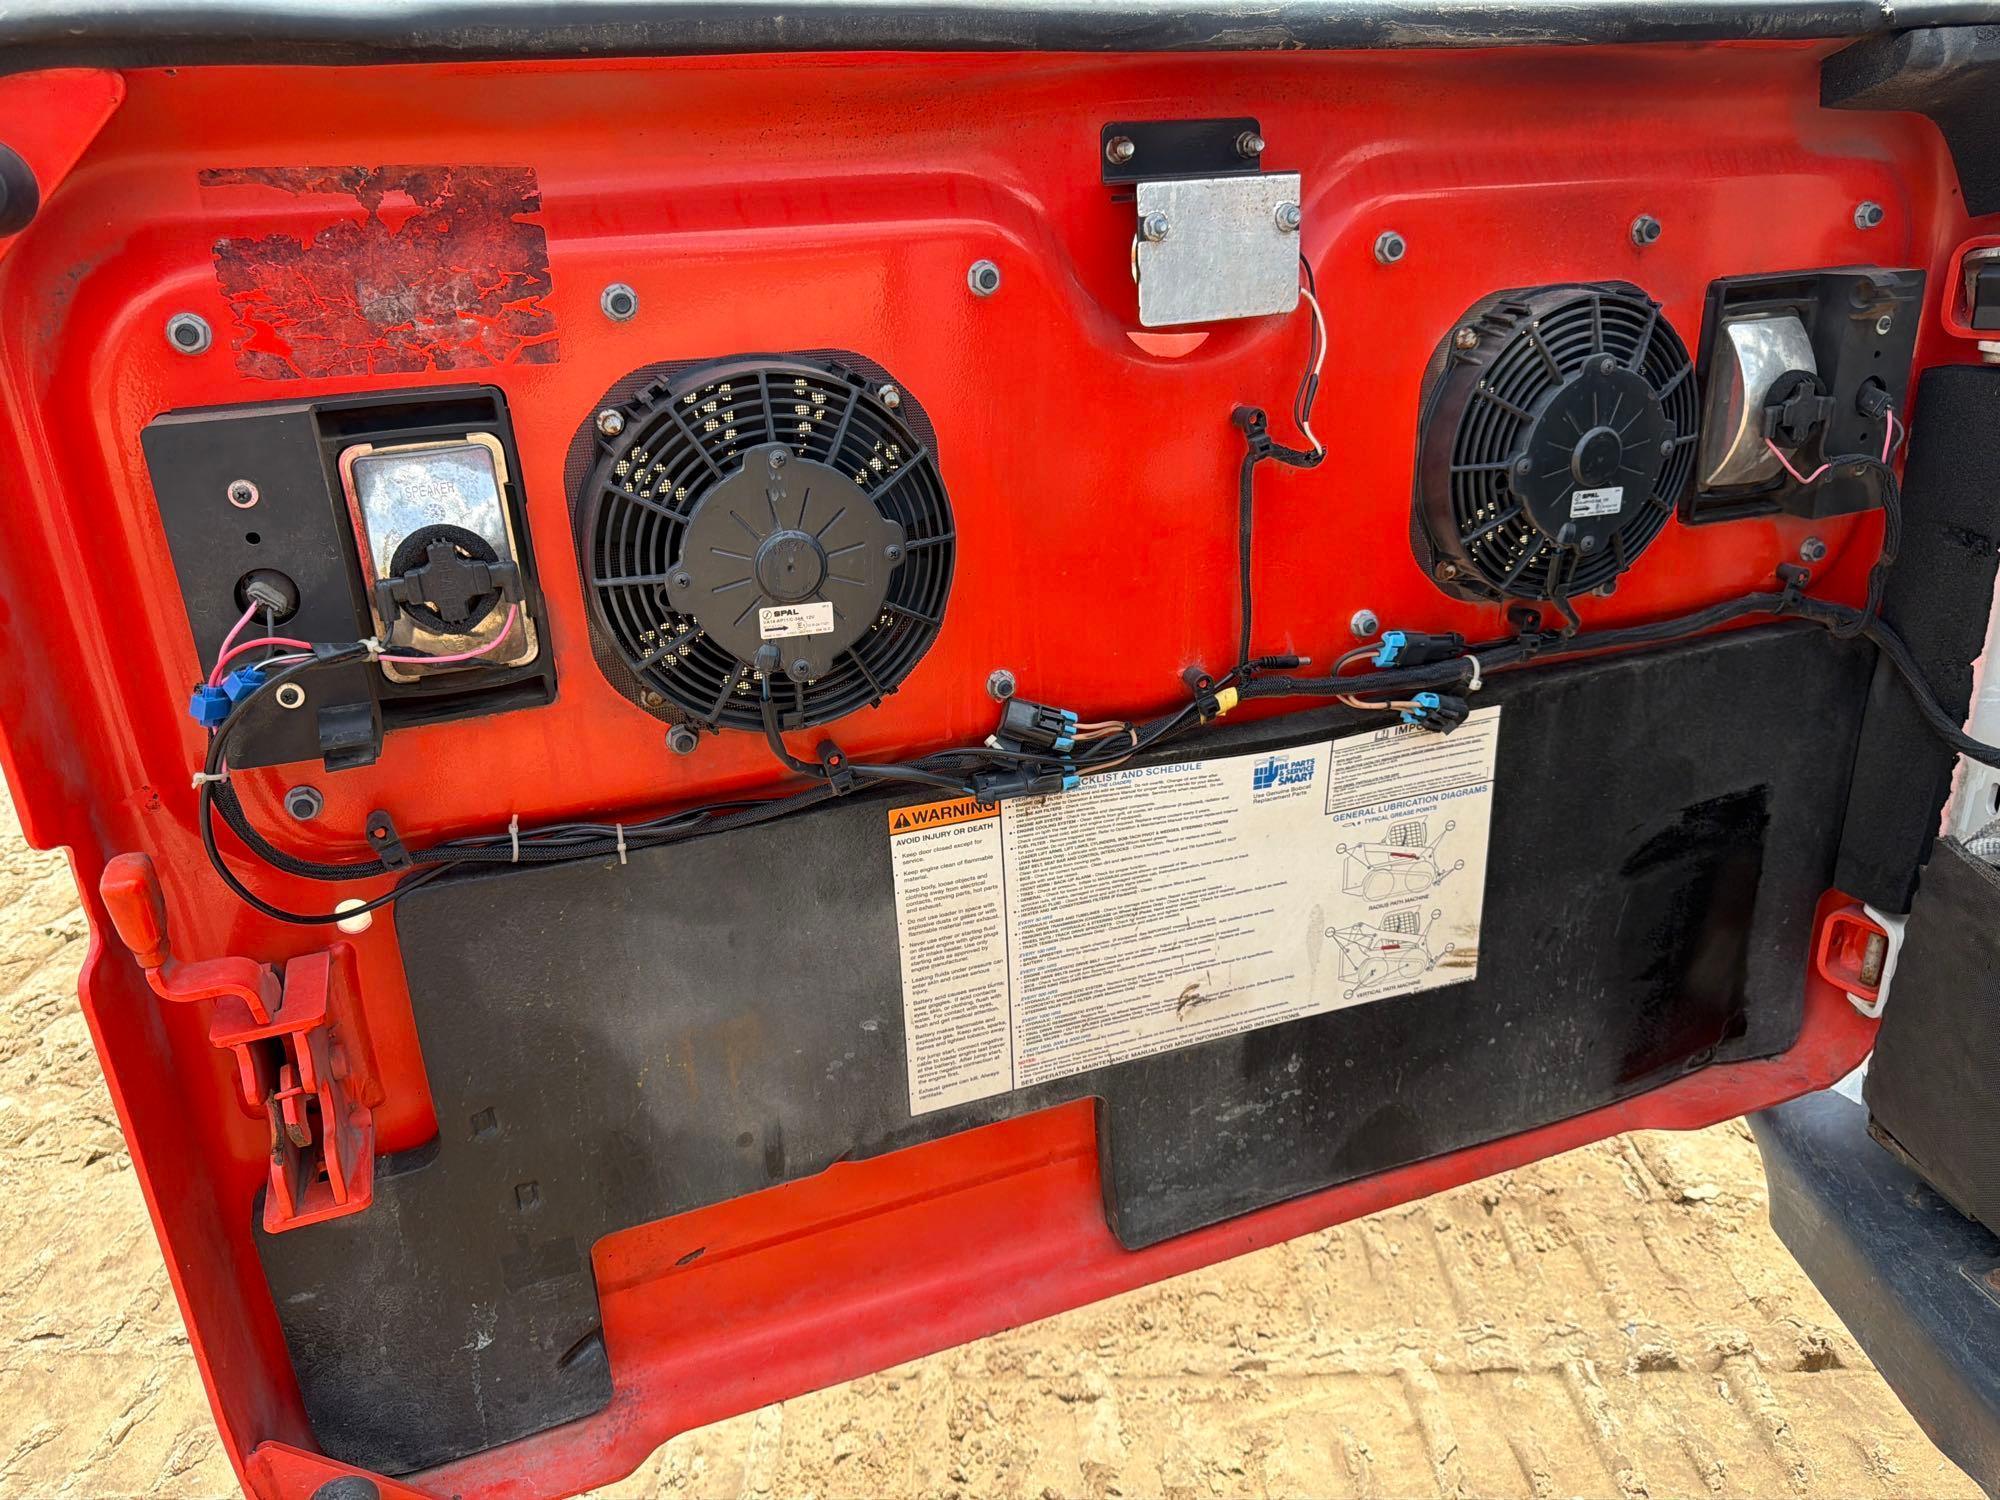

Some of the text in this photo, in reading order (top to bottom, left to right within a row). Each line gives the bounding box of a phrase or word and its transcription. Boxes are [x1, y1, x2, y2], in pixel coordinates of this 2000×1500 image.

[1286, 765, 1314, 775] SERVICE
[1291, 758, 1315, 768] PARTS
[1079, 762, 1202, 786] CKLIST AND SCHEDULE
[1278, 771, 1314, 786] SMART
[1253, 794, 1290, 805] Replacement
[1266, 788, 1289, 796] Genuine
[1291, 784, 1311, 792] Bobcat
[1333, 784, 1487, 822] GENERAL LUBRICATION DIAGRAMS
[912, 801, 996, 825] WARNING
[1364, 805, 1437, 824] TYPICAL GREASE POINTS
[896, 836, 920, 846] AVOID
[922, 830, 951, 841] INJURY
[967, 822, 993, 833] DEATH
[902, 851, 917, 860] Keep
[954, 841, 973, 850] except
[904, 869, 918, 877] Keep
[920, 865, 939, 874] engine
[964, 855, 993, 864] flammable
[905, 887, 920, 895] Keep
[921, 884, 936, 892] body,
[955, 876, 976, 885] objects
[905, 892, 928, 901] clothing
[930, 889, 944, 897] away
[960, 880, 985, 889] electrical
[906, 898, 932, 907] contacts,
[933, 893, 955, 903] moving
[955, 890, 971, 898] parts,
[983, 884, 998, 892] parts
[1369, 903, 1389, 911] RADIUS
[1405, 894, 1430, 903] MACHINE
[919, 902, 942, 911] exhaust.
[939, 910, 957, 918] loader
[965, 906, 982, 914] space
[908, 921, 935, 932] explosive
[960, 913, 977, 921] gases
[909, 927, 938, 937] flammable
[938, 922, 961, 930] material
[976, 914, 999, 923] exhaust.
[936, 940, 955, 949] engine
[969, 934, 982, 942] glow
[983, 931, 999, 939] plugs
[961, 928, 983, 937] starting
[911, 958, 932, 967] starting
[954, 947, 981, 958] approved
[926, 949, 943, 957] intake
[944, 945, 962, 953] heater.
[976, 939, 988, 947] only
[911, 956, 968, 973] engine manufacturer.
[912, 974, 933, 984] Leaking
[968, 962, 992, 971] pressure
[970, 968, 990, 976] serious
[1356, 989, 1381, 999] VERTICAL
[1397, 979, 1420, 989] MACHINE
[1021, 1078, 1036, 1086] SEE
[1037, 1068, 1074, 1081] OPERATION
[1082, 1055, 1129, 1070] MAINTENANCE
[1131, 1047, 1158, 1058] MANUAL
[1160, 1043, 1173, 1051] FOR
[1175, 1038, 1193, 1047] MORE
[1195, 1027, 1238, 1042] INFORMATION
[1239, 1023, 1253, 1031] AND
[1254, 1012, 1300, 1027] INSTRUCTIONS.
